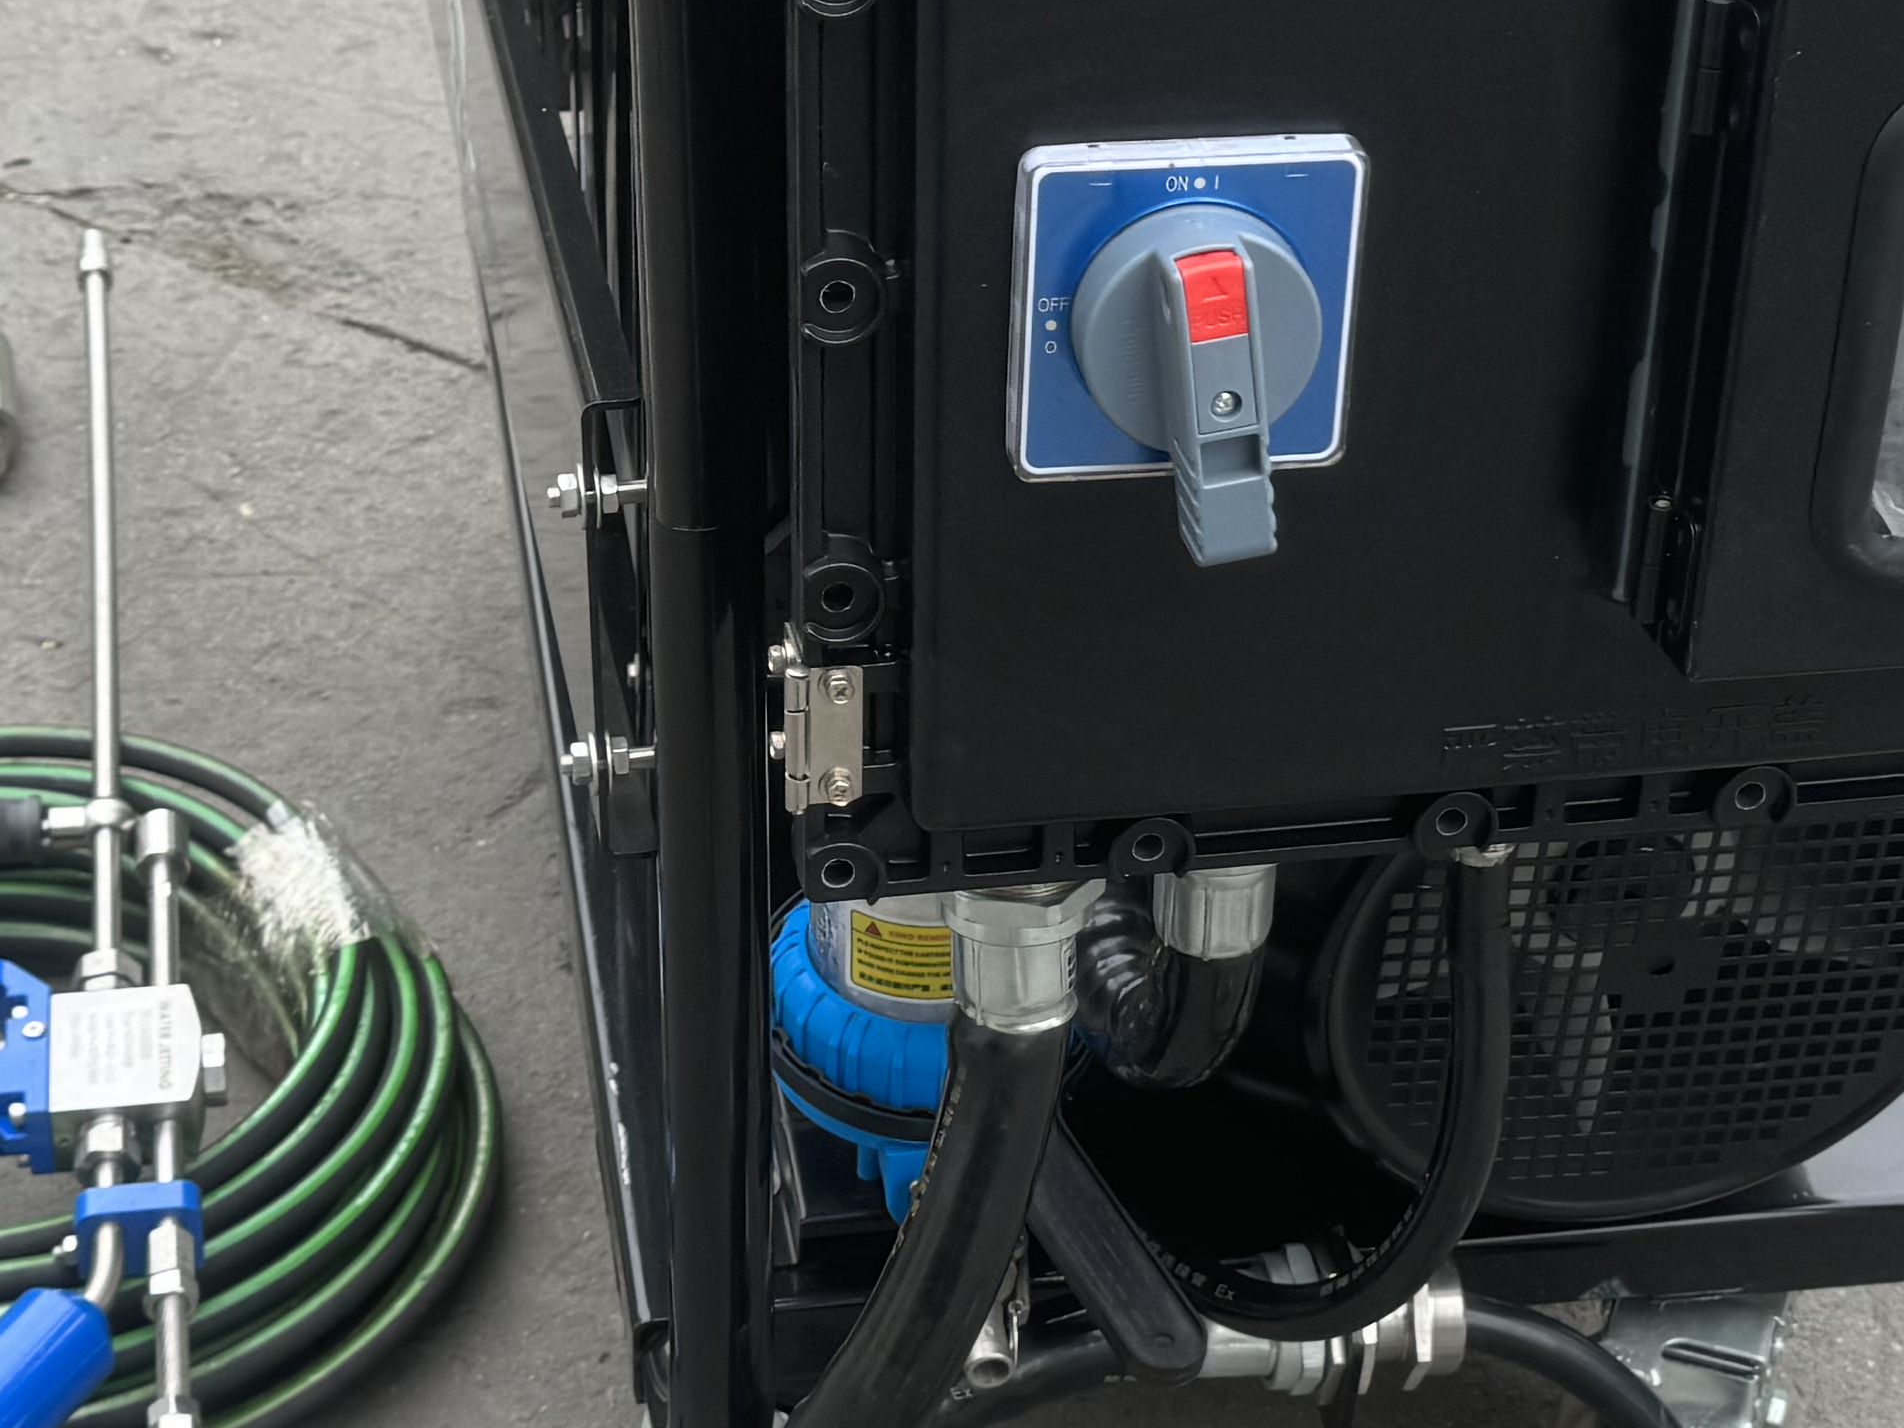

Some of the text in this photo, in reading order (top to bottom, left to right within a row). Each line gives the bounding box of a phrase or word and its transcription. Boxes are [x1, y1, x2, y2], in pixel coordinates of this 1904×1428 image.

[1165, 175, 1189, 193] ON
[1037, 296, 1071, 312] OFF
[1191, 310, 1245, 330] PUSH
